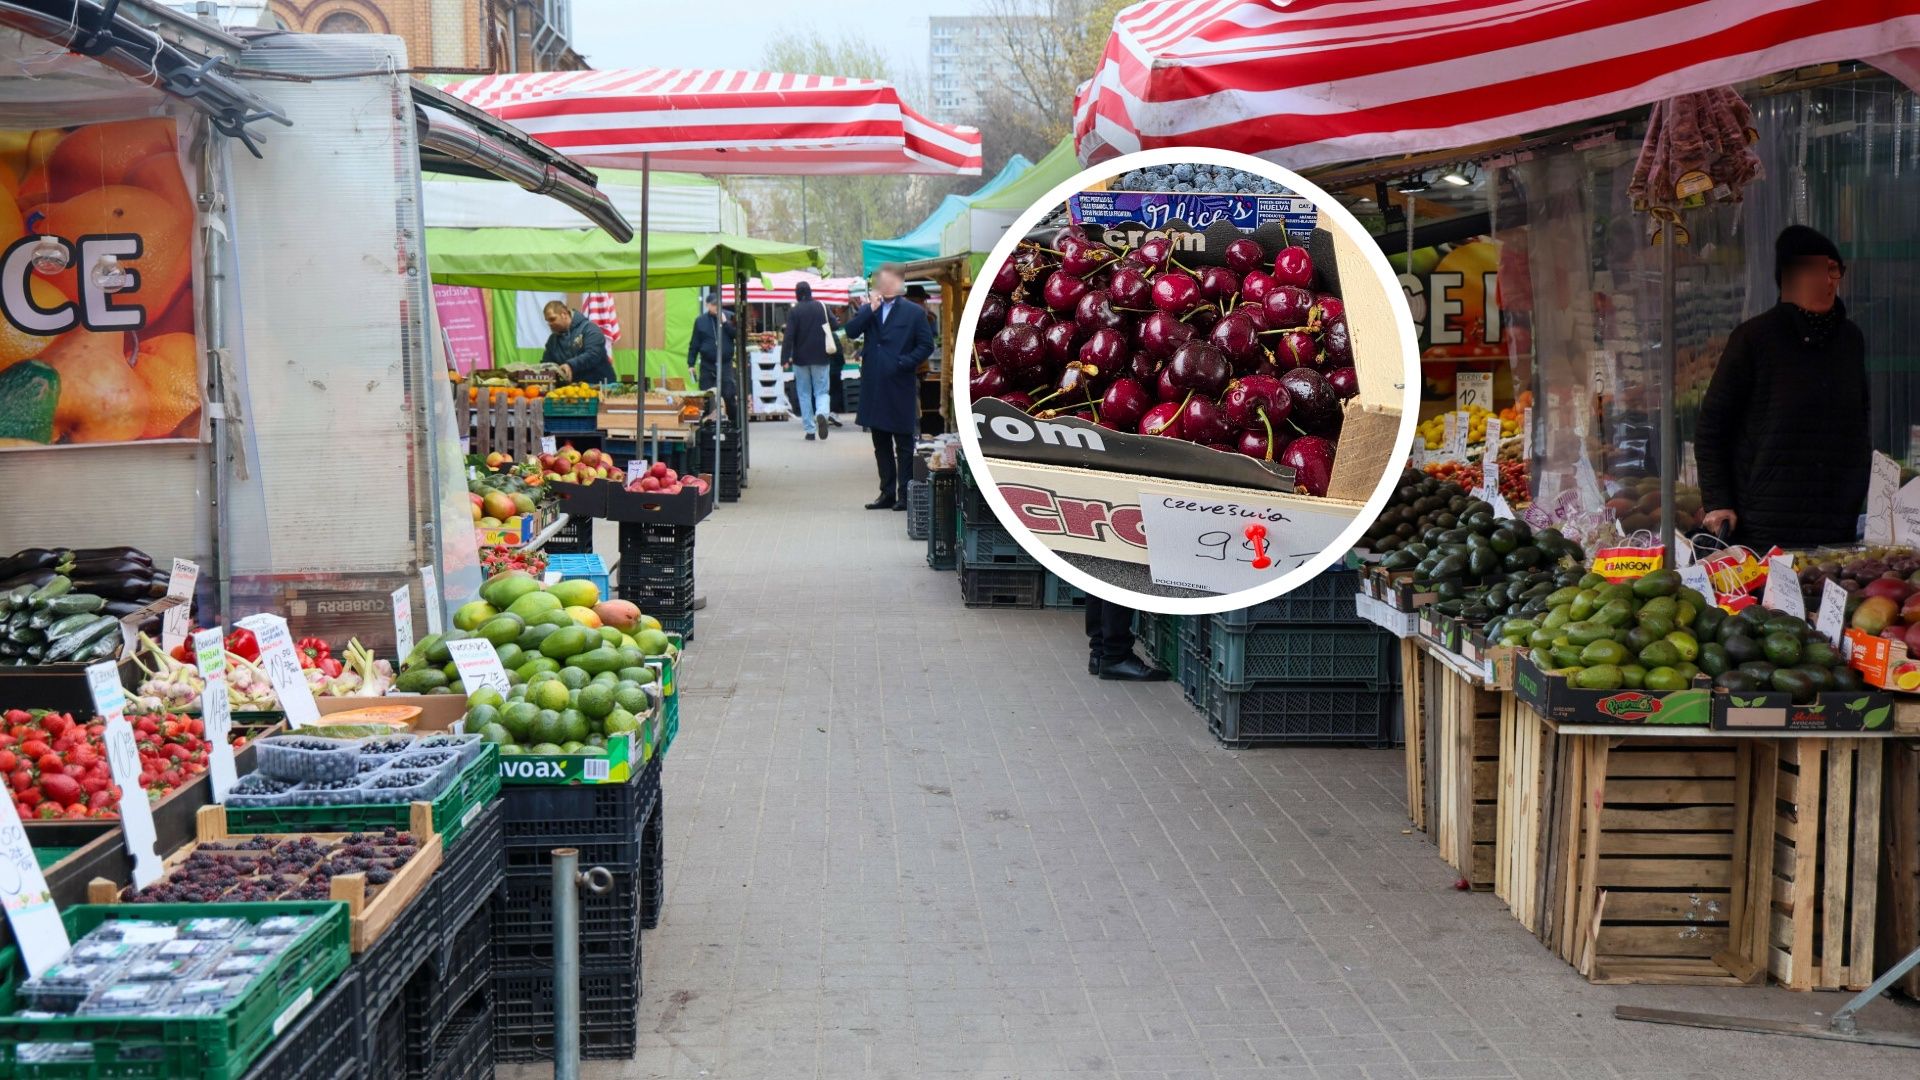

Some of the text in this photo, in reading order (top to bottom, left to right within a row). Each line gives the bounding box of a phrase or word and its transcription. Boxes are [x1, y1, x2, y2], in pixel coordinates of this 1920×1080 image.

[1459, 389, 1476, 406] 12
[1155, 578, 1212, 591] POCHODZENIE:
[317, 600, 385, 613] CURBERRY
